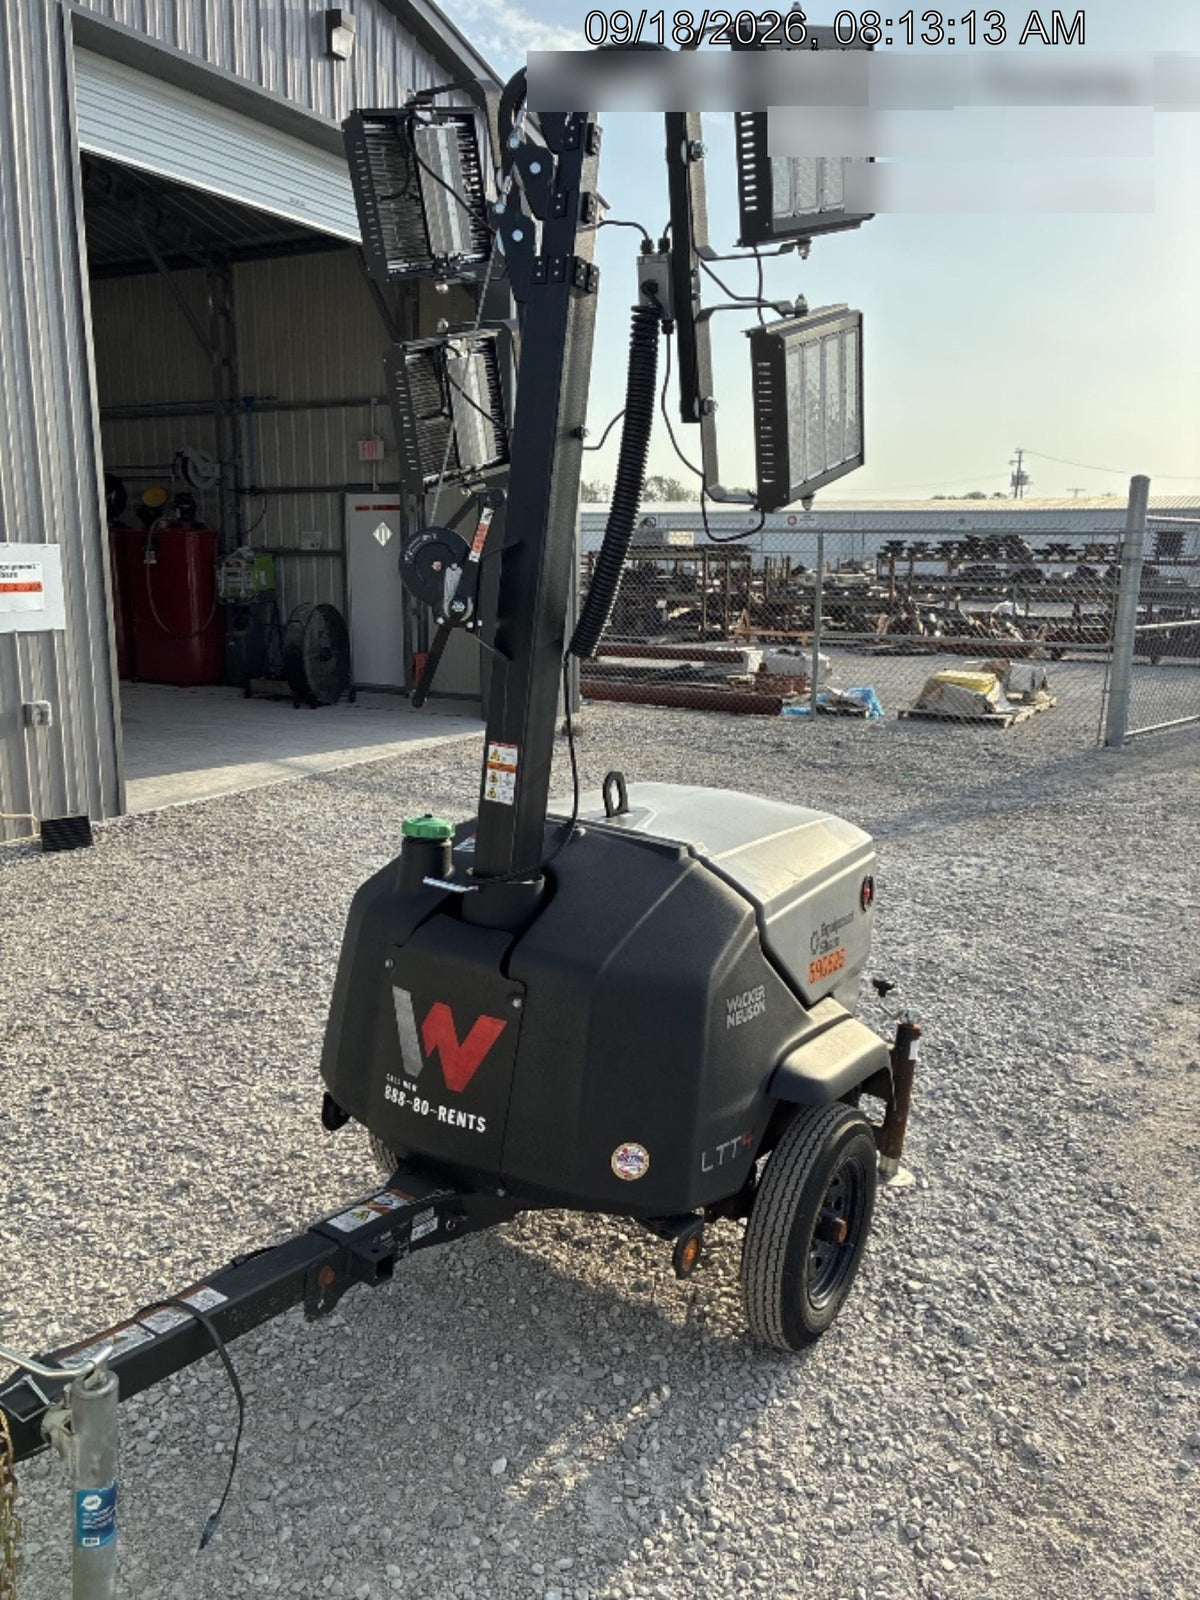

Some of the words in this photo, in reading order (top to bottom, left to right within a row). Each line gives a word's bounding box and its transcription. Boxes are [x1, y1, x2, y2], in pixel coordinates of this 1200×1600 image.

[726, 984, 766, 1013] WACKER
[726, 999, 766, 1030] NEUSON
[384, 1084, 486, 1133] 888-80-RENTS
